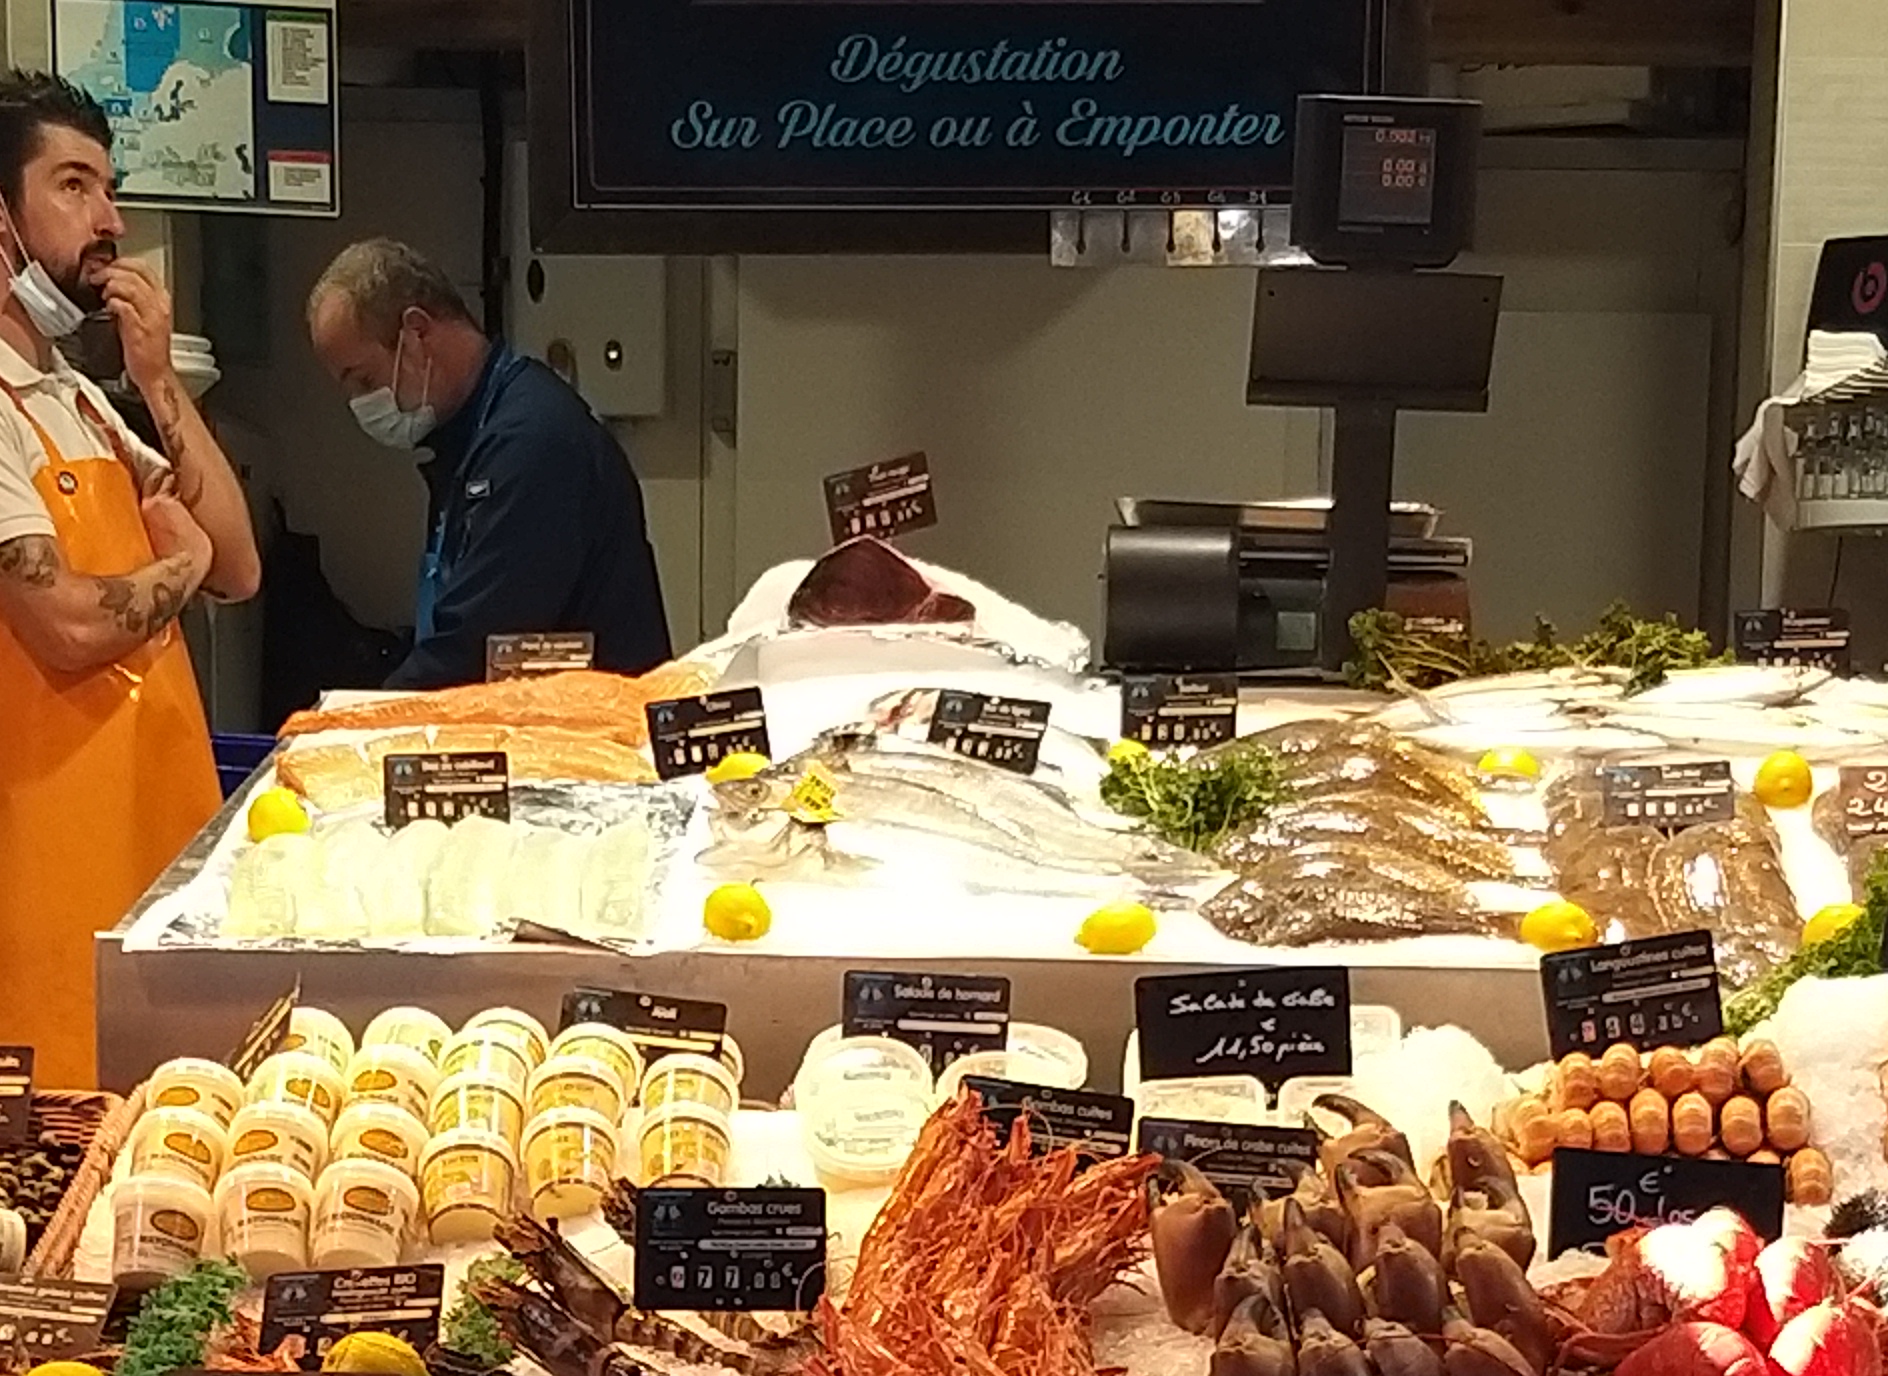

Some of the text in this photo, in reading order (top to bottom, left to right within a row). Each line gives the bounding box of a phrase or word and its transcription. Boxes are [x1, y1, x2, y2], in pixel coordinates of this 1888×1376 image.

[830, 33, 1124, 93] Dégustation
[672, 98, 1287, 158] Sur Place ou à Emporter
[1638, 1171, 1660, 1194] €
